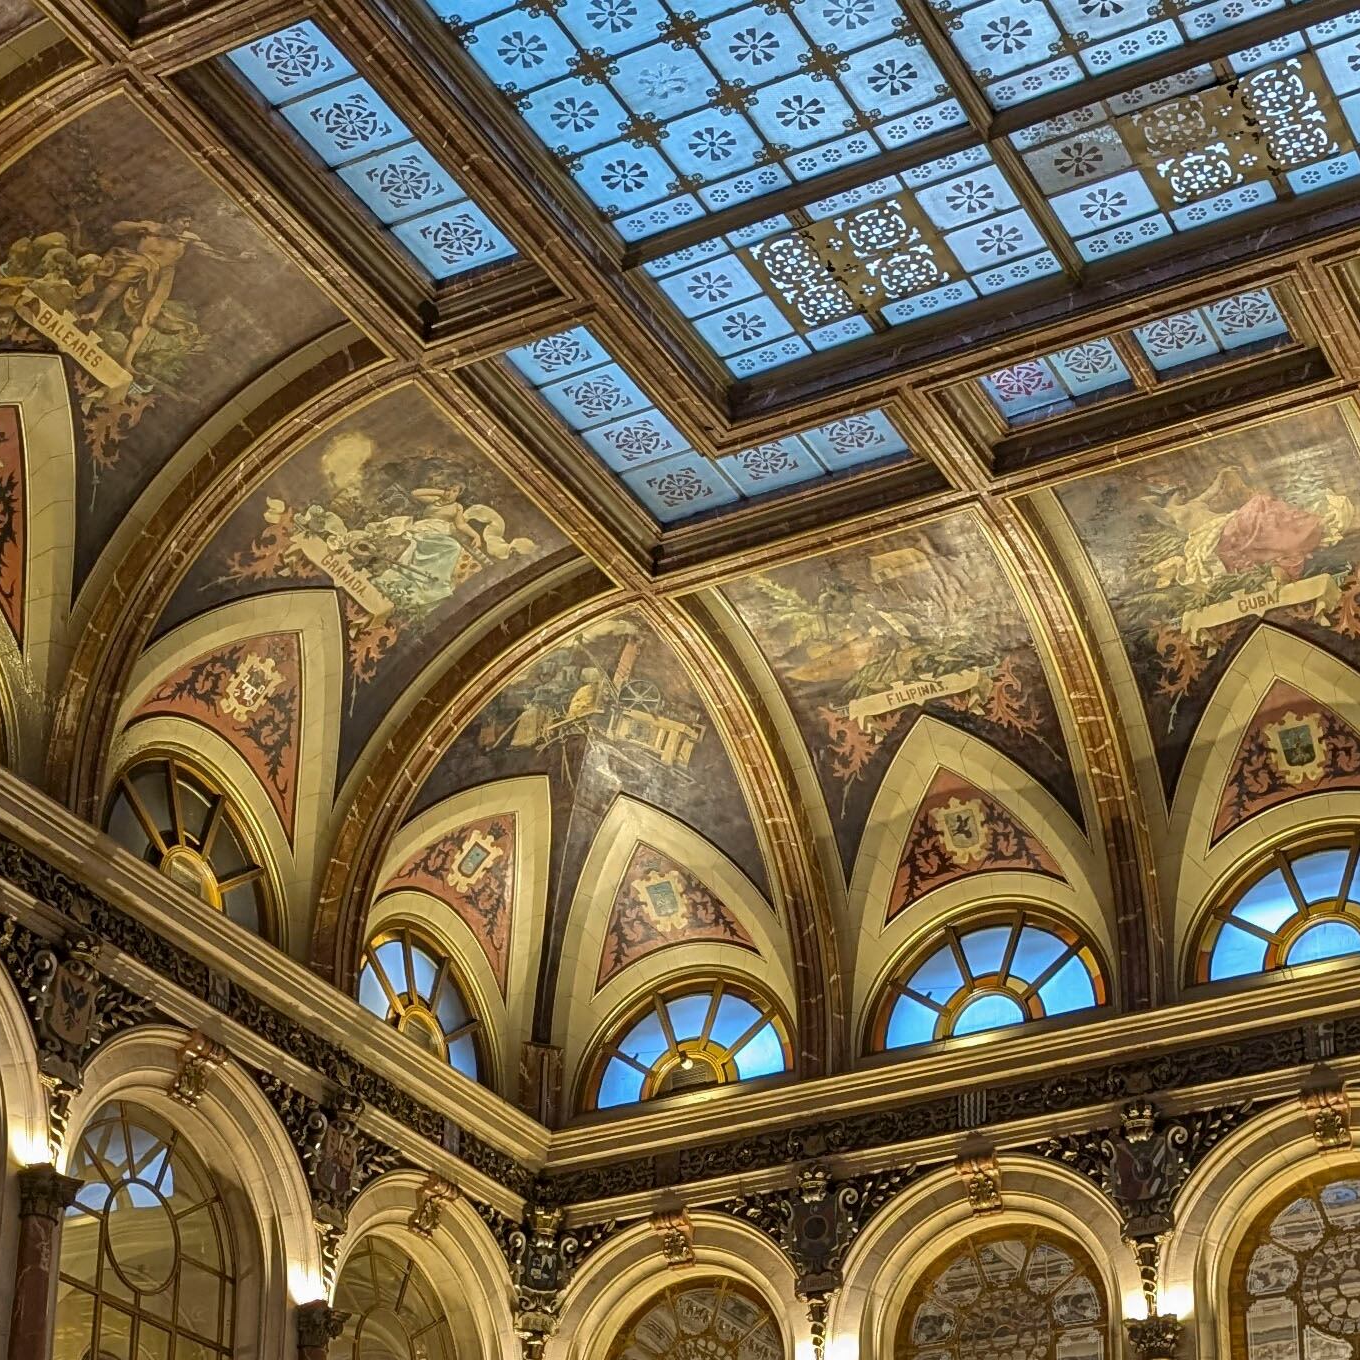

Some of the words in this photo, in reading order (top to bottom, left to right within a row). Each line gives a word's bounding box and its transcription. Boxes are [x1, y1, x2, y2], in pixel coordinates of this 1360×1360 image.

[38, 310, 103, 368] BALEARES
[321, 555, 367, 599] GRANADA.
[885, 681, 948, 706] FILIPINAS.
